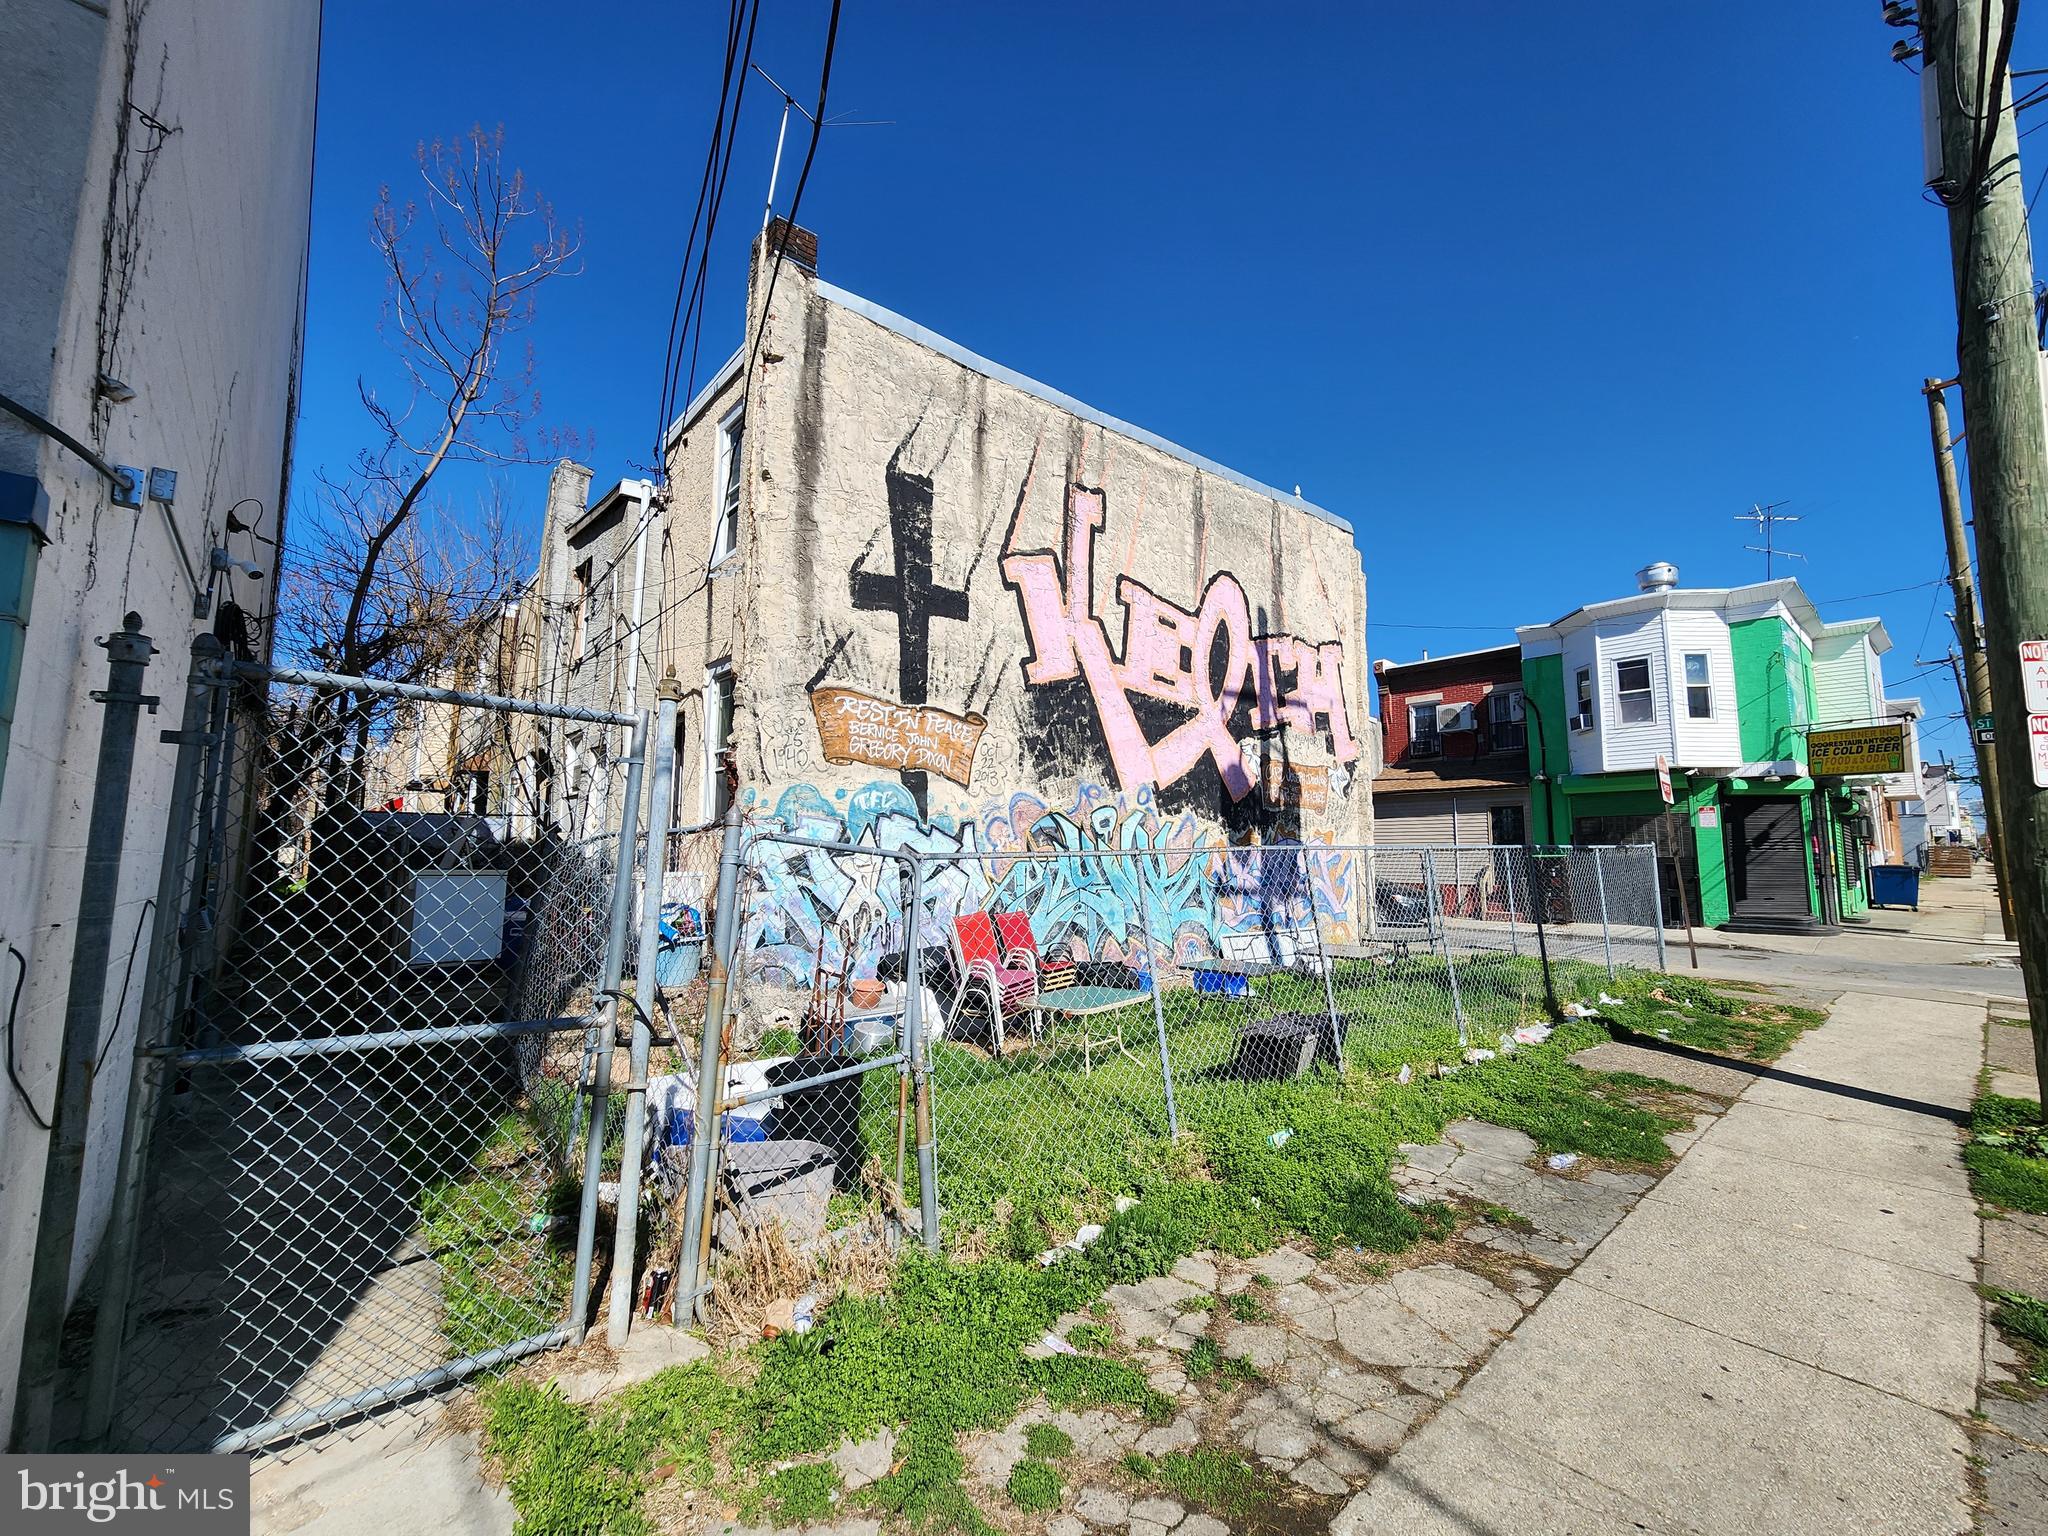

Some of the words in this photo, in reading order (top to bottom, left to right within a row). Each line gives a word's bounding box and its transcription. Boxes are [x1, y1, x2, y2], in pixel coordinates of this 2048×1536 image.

[2023, 645, 2040, 658] NO
[834, 696, 896, 724] REST
[894, 711, 921, 730] IN
[925, 712, 973, 743] PEACE
[849, 722, 900, 743] BERNICE
[906, 732, 939, 750] JOHN
[1828, 738, 1879, 747] RESTAURANT
[1833, 731, 1877, 741] STERNER
[849, 737, 911, 767] GREGORY
[915, 748, 952, 773] DIXON
[1812, 748, 1830, 757] ICE
[1833, 745, 1863, 756] COLD
[1868, 742, 1900, 753] BEER
[981, 758, 994, 770] 22
[1824, 756, 1851, 766] FOOD
[1859, 753, 1886, 763] SODA
[974, 769, 999, 786] 2013
